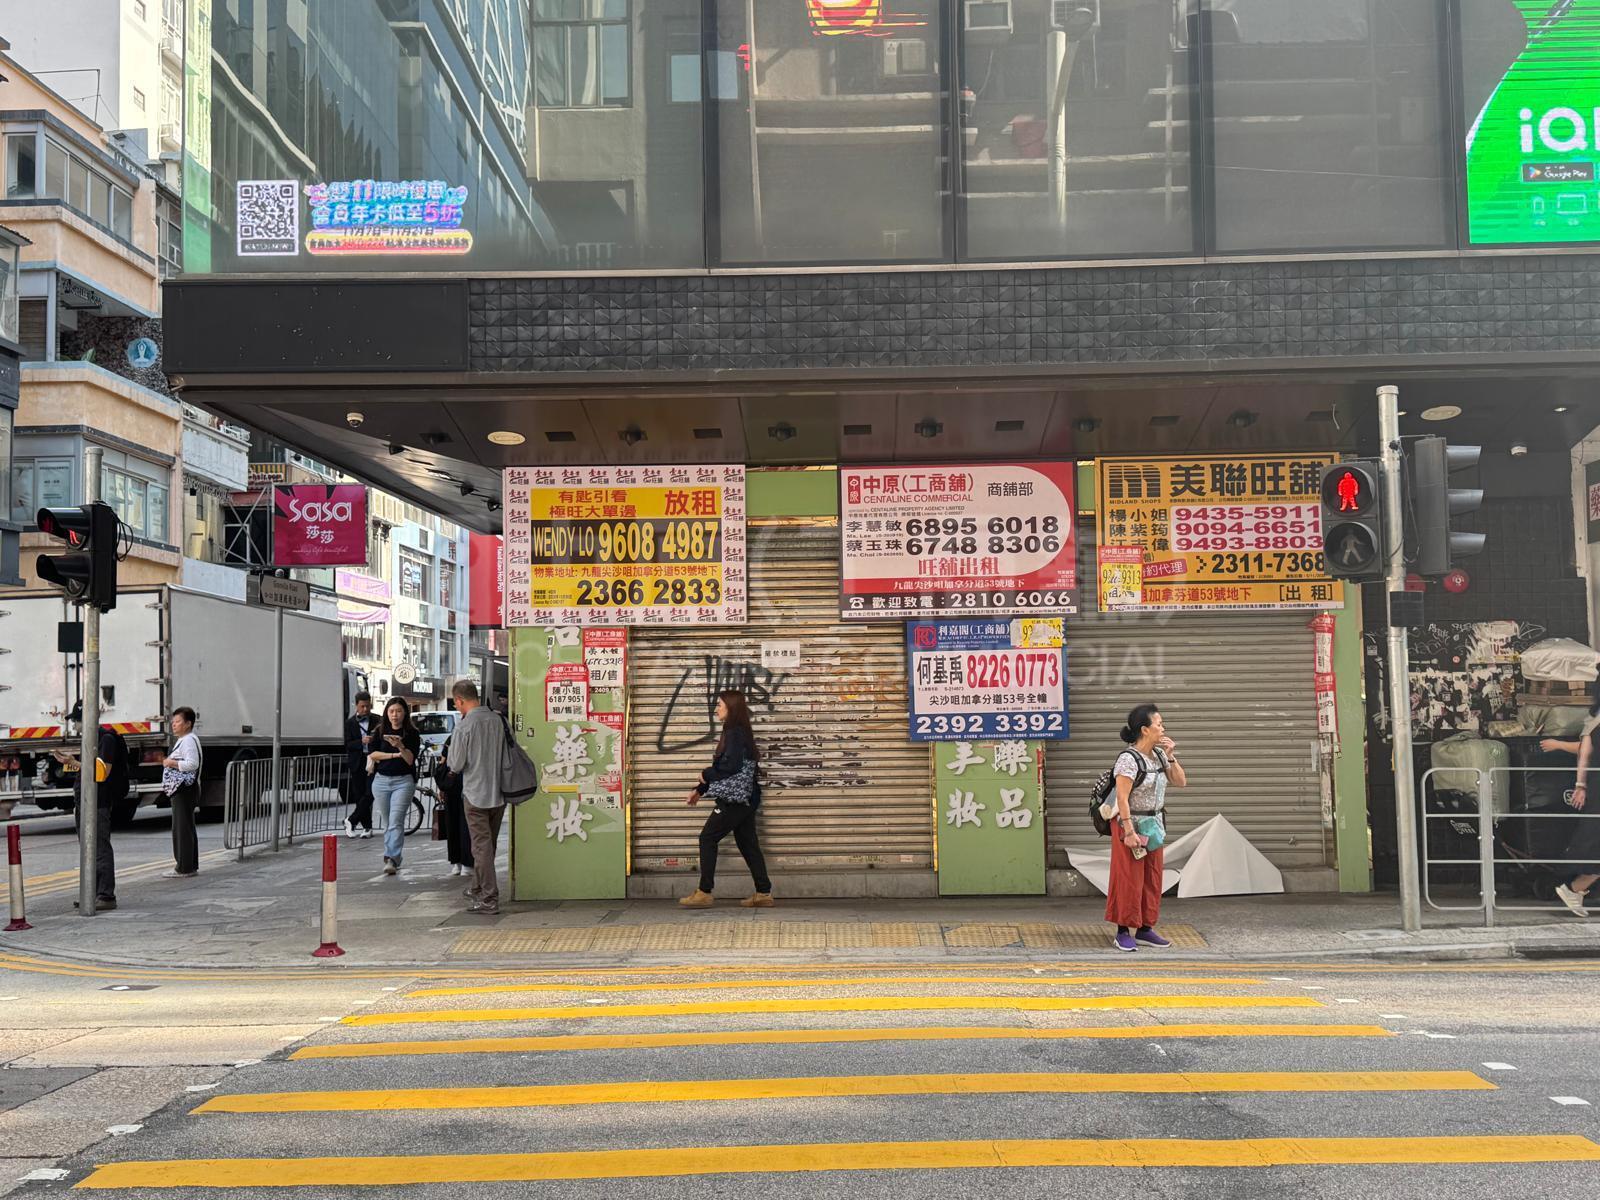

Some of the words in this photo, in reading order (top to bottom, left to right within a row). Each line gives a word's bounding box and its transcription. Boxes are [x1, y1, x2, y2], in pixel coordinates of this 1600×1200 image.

[863, 473, 974, 494] 中原(工商舖)
[1170, 462, 1325, 497] 美聯旺舖
[558, 490, 627, 504] 有匙引看
[863, 494, 912, 504] CENTALINE
[914, 493, 974, 503] COMMERCIAL
[987, 482, 1034, 497] 商舖部
[550, 505, 636, 518] 極旺大單邊
[664, 489, 717, 516] 放租
[1109, 508, 1168, 523] 楊小姐
[1175, 505, 1320, 521] 9435-5911
[306, 525, 334, 544] 莎莎
[846, 519, 903, 533] 李慧敏
[905, 517, 977, 536] 6895
[987, 516, 1059, 534] 6018
[1175, 520, 1320, 536] 9094-6651
[533, 526, 575, 558] WENDY
[578, 526, 594, 557] LO
[598, 522, 655, 561] 9608
[661, 521, 719, 561] 4987
[846, 539, 903, 551] 蔡玉珠
[906, 537, 977, 555] 6748
[987, 535, 1060, 554] 8306
[1175, 535, 1324, 551] 9493-8803
[918, 557, 1000, 576] 旺舖出租
[1143, 561, 1184, 577] 約代理
[1211, 552, 1325, 574] 2311-7368
[534, 567, 578, 578] 物業地址:
[576, 579, 644, 606] 2366
[653, 578, 721, 605] 2833
[951, 592, 1005, 608] 2810
[1015, 591, 1071, 606] 6066
[938, 624, 1010, 636] 利嘉閣(工商舖)
[590, 670, 618, 681] 租/售
[916, 655, 963, 686] 何基禹
[967, 653, 1010, 688] 8226
[1015, 652, 1059, 687] 0773
[552, 686, 581, 695] 陳小姐
[916, 715, 984, 734] 2392
[995, 713, 1063, 732] 3392
